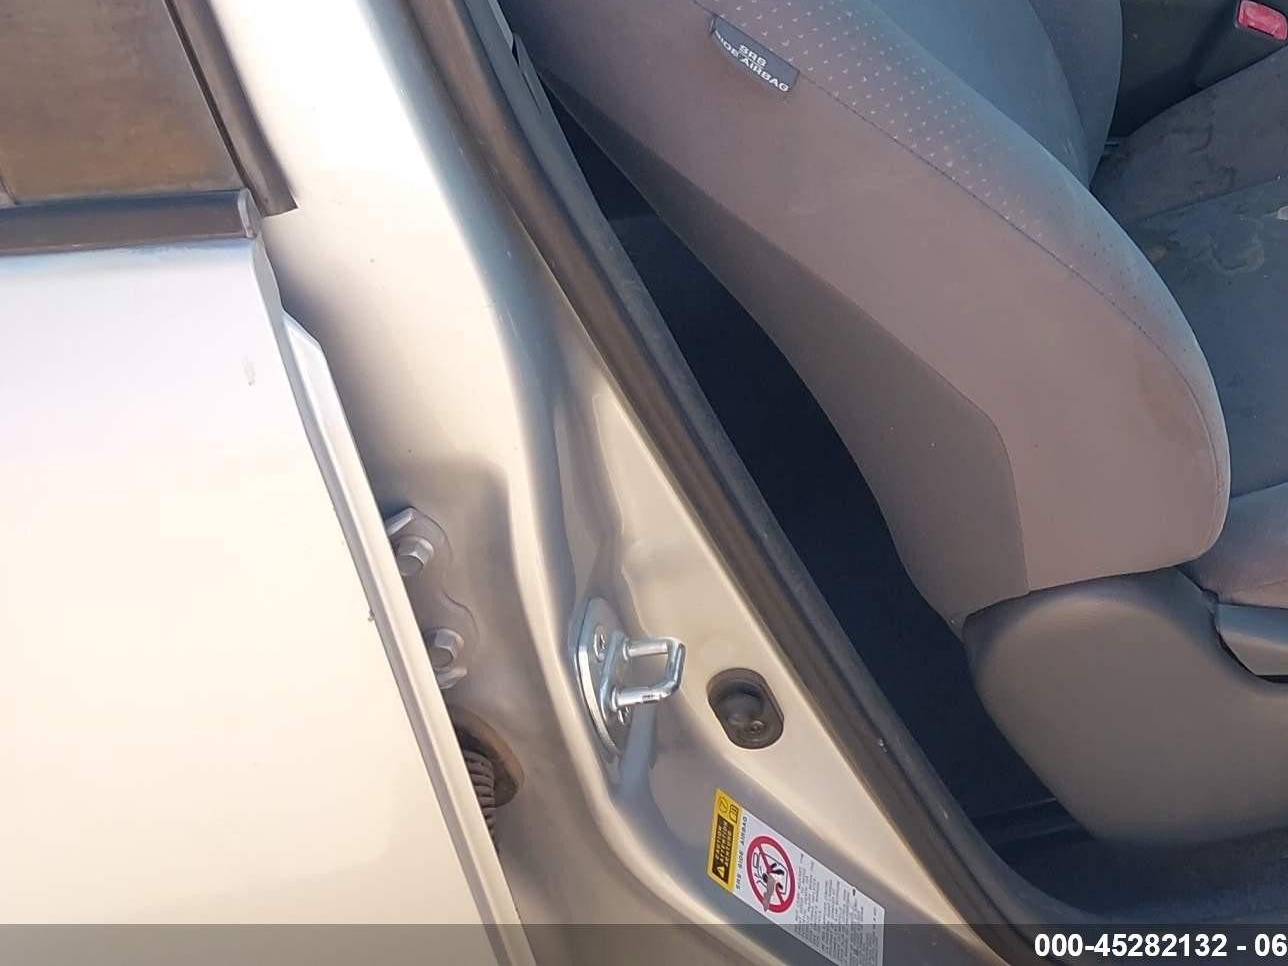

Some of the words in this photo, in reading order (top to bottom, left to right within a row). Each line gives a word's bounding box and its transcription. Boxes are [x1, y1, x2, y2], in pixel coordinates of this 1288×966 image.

[739, 44, 767, 67] SRS
[739, 57, 790, 92] AIRBAG
[740, 816, 748, 846] AIRBAG
